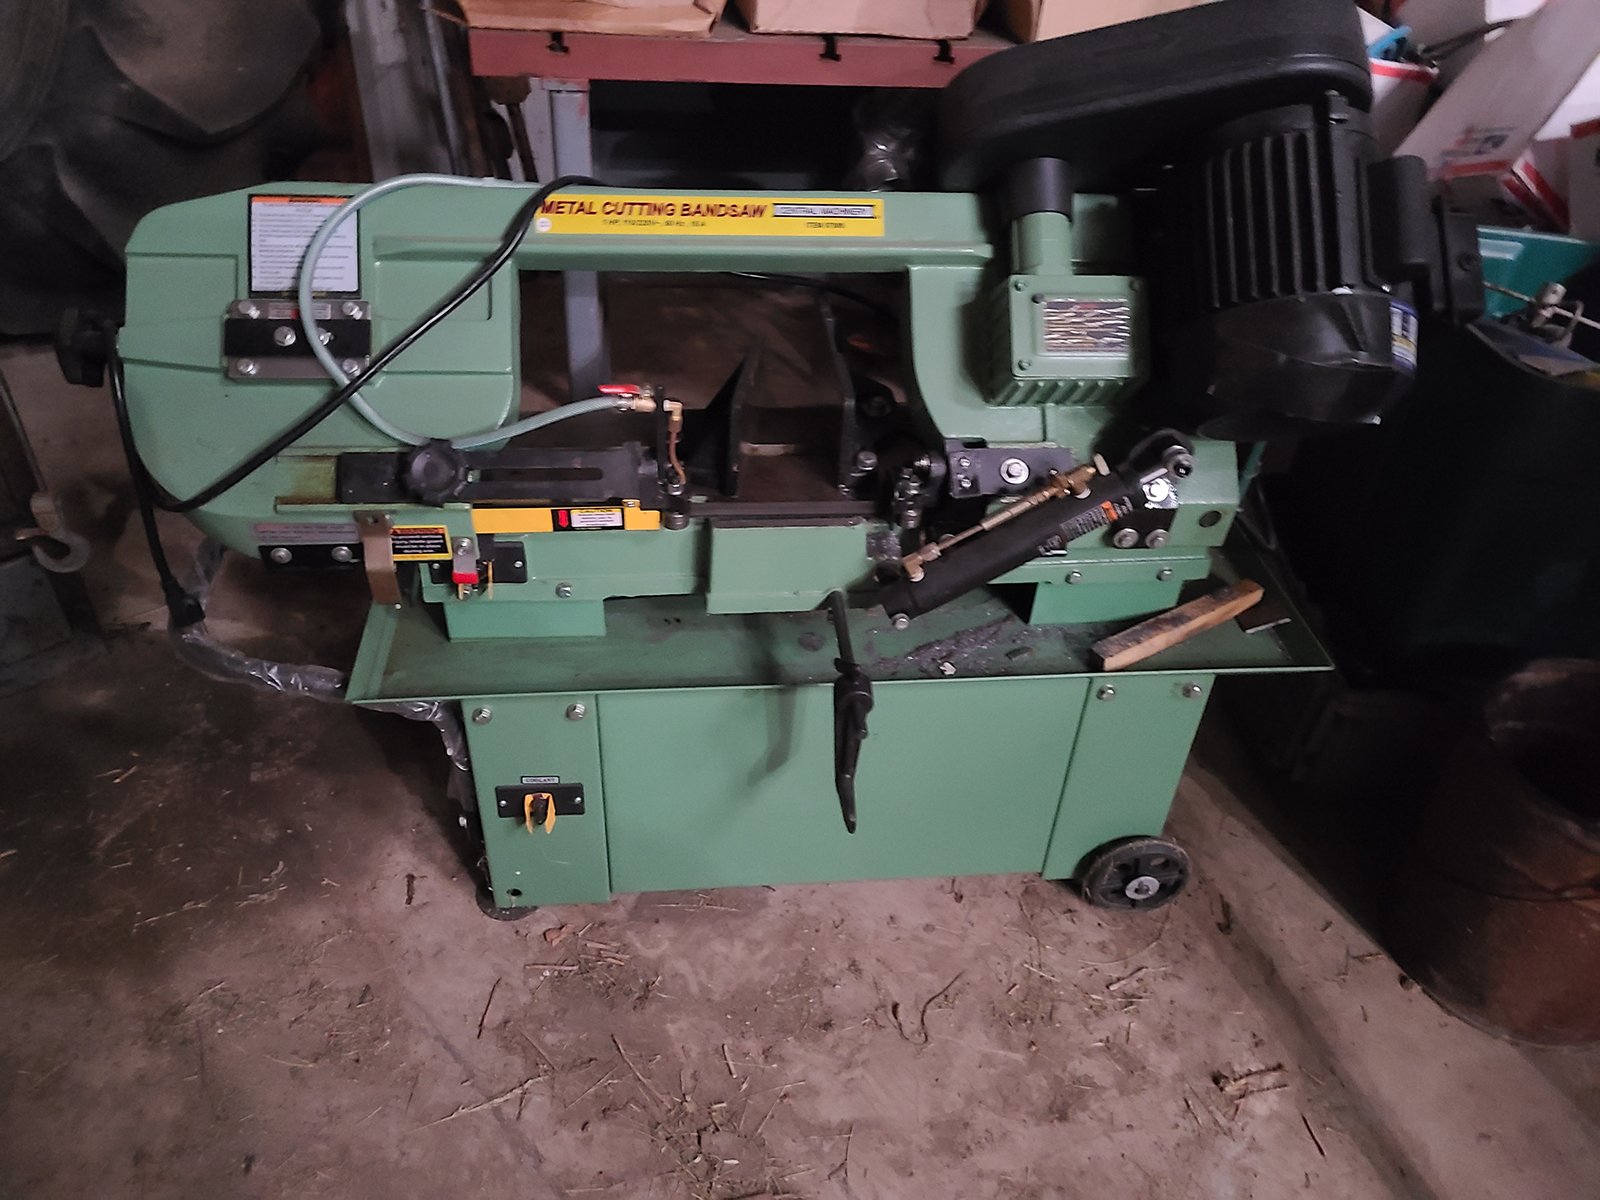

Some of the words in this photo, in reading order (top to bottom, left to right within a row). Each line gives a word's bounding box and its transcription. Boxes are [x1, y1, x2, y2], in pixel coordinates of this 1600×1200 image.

[541, 200, 597, 215] METAL
[602, 201, 676, 216] CUTTING
[680, 203, 768, 218] BANDSAW
